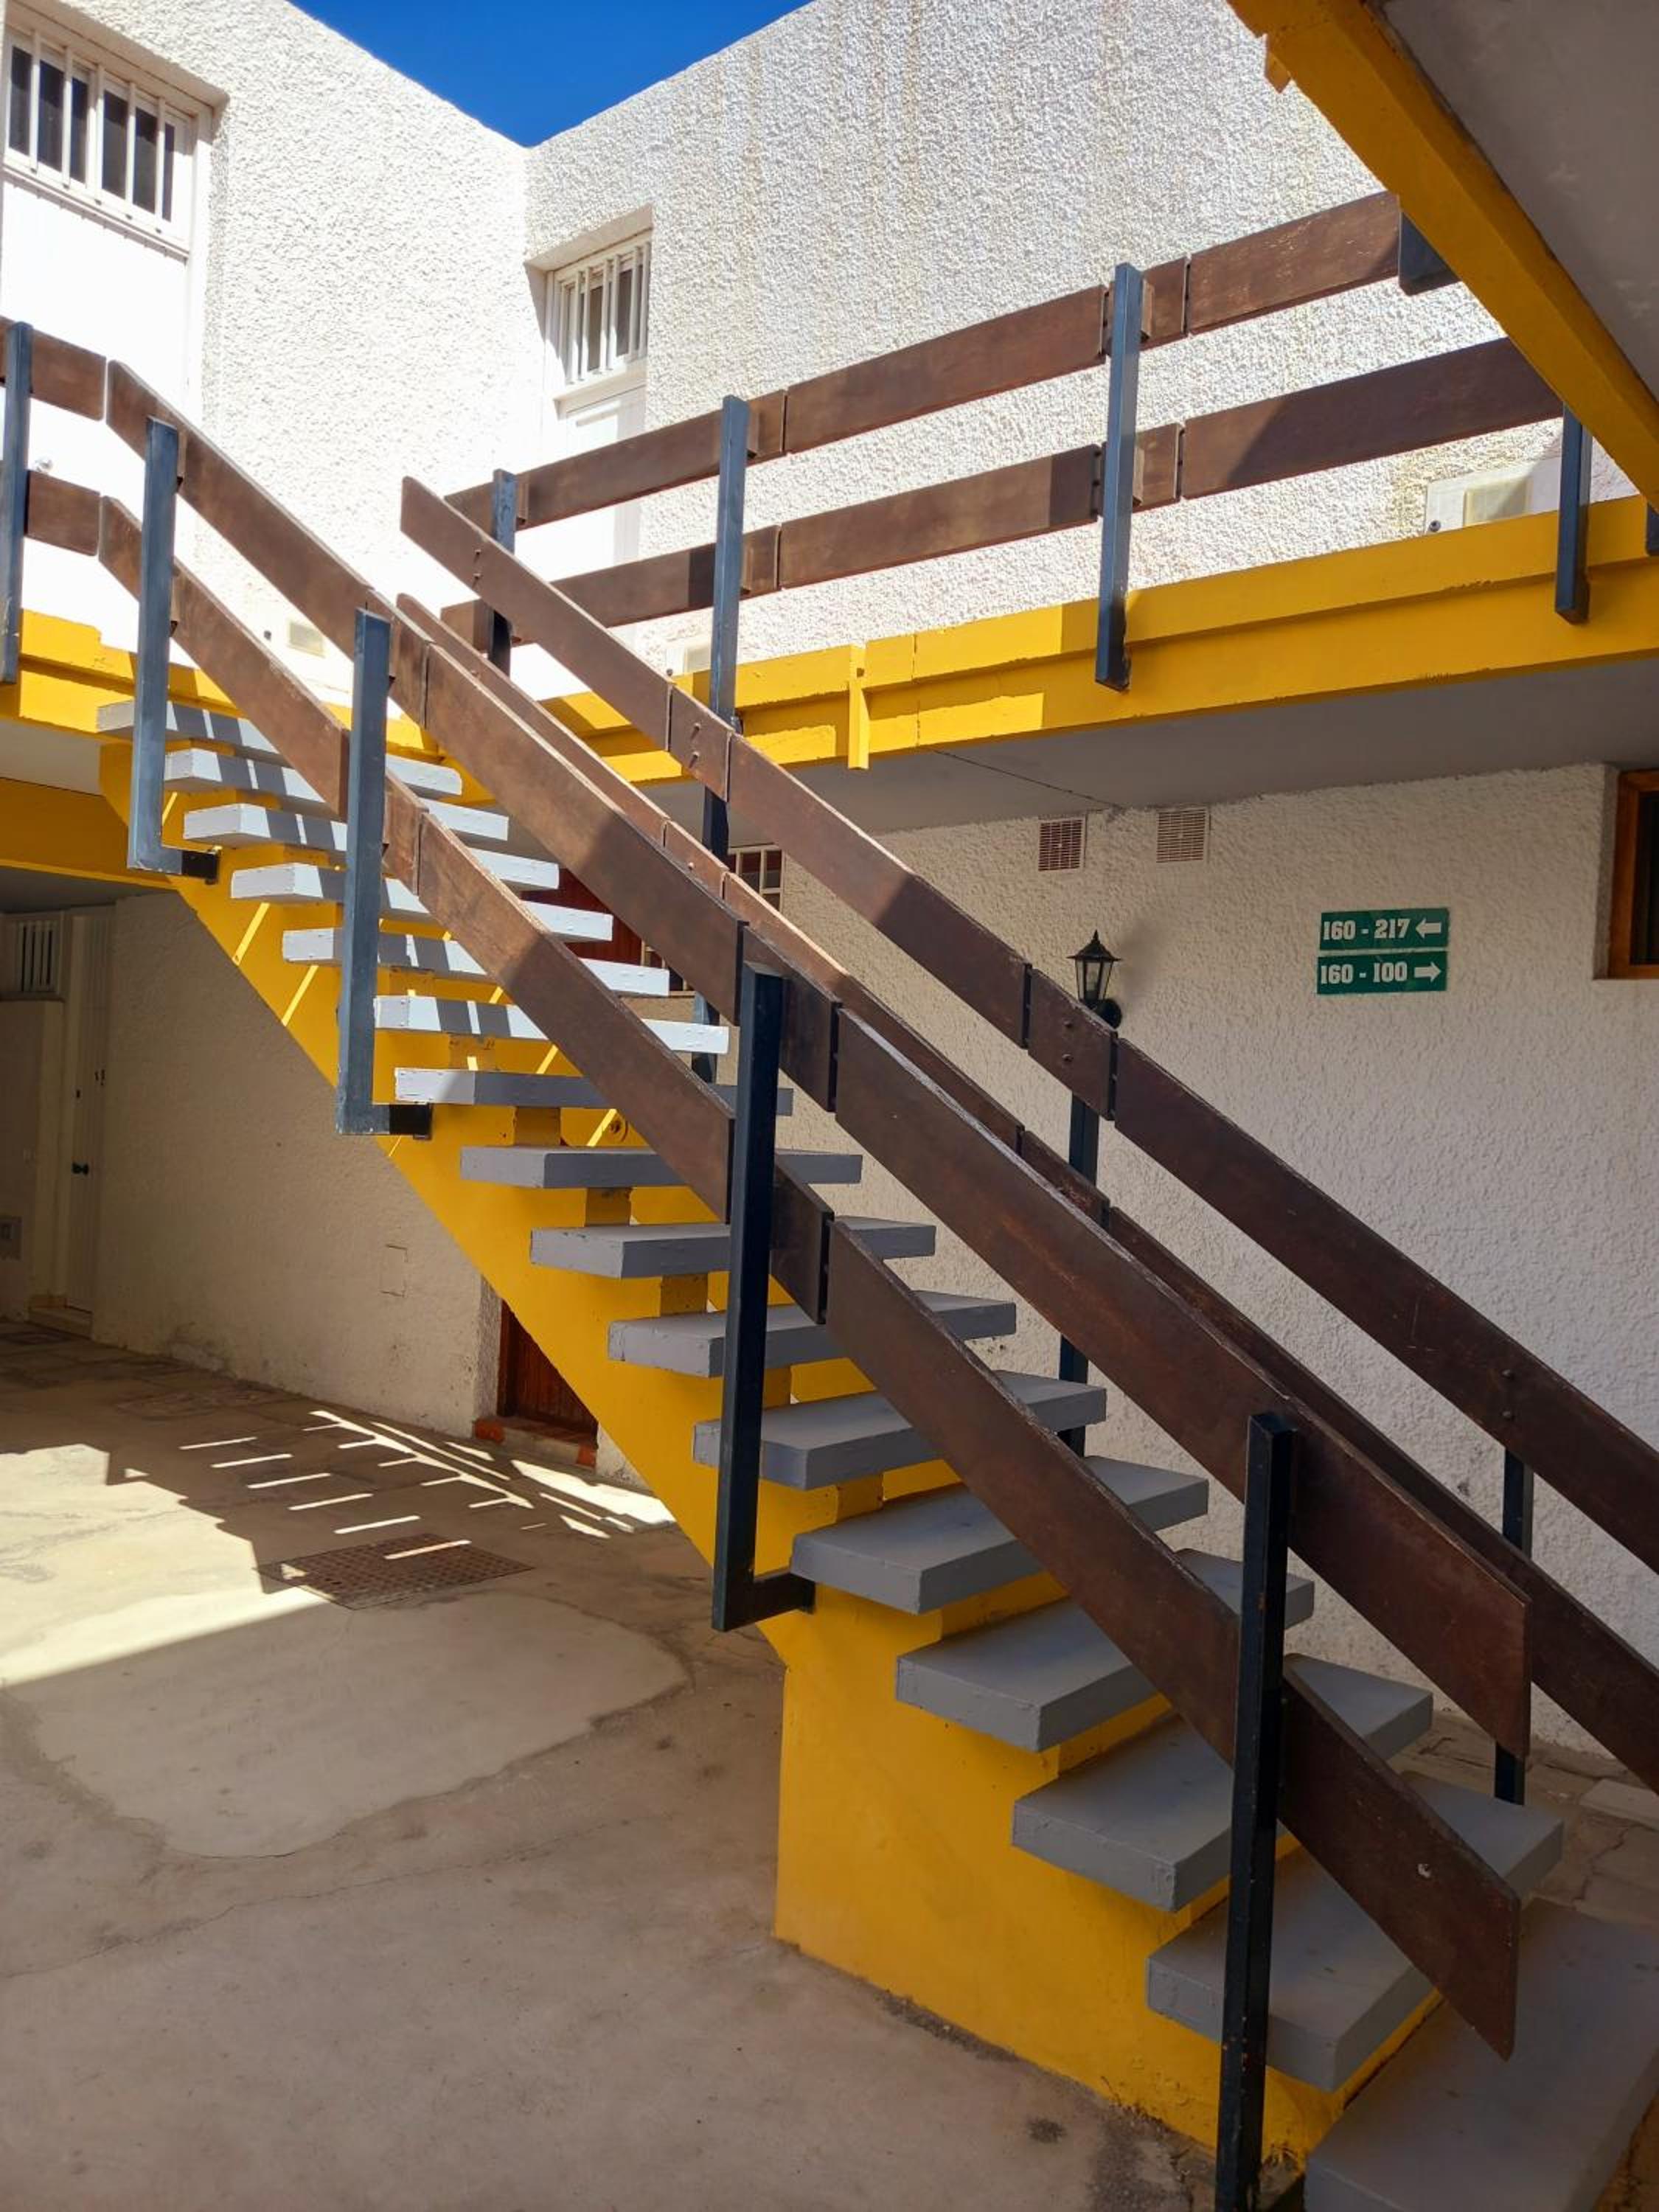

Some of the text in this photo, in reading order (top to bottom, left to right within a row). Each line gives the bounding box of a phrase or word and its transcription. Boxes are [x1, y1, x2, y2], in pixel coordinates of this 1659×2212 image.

[1323, 920, 1356, 940] 160
[1374, 918, 1411, 939] 217
[1321, 964, 1354, 984] 160
[1373, 961, 1408, 983] 100
